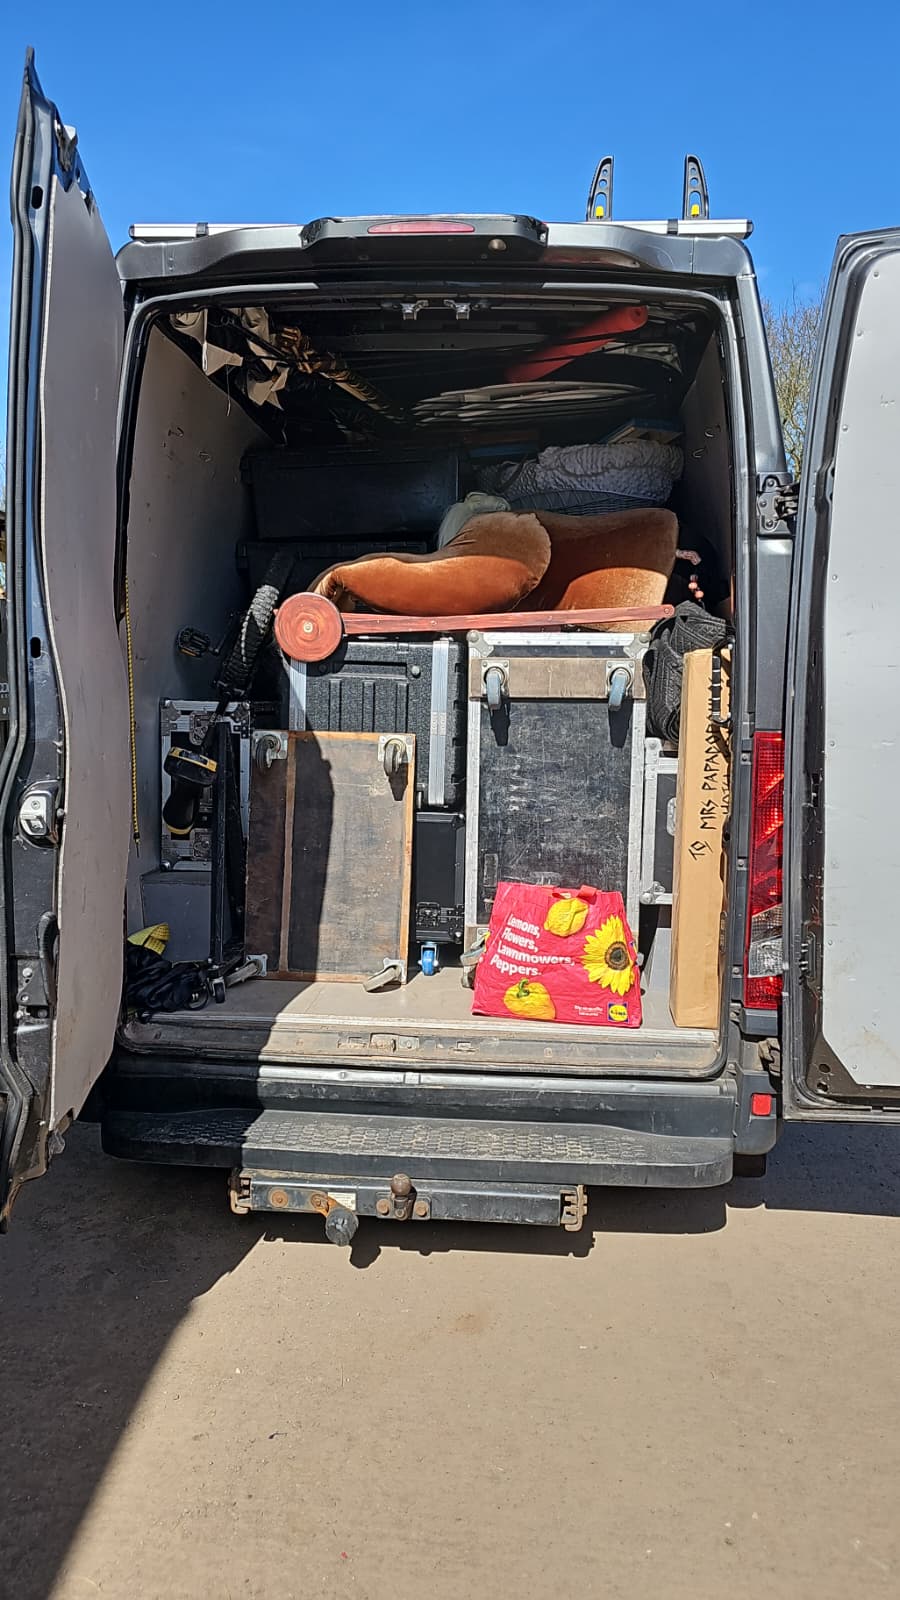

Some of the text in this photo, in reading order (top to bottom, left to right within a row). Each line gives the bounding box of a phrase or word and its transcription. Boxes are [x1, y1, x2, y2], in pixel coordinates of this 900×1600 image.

[688, 677, 725, 860] TO MRS PAPADOP
[507, 913, 540, 939] Lemons,
[501, 927, 539, 953] Flowers,
[490, 953, 542, 976] Peppers.
[497, 940, 575, 967] Lawnmowers,
